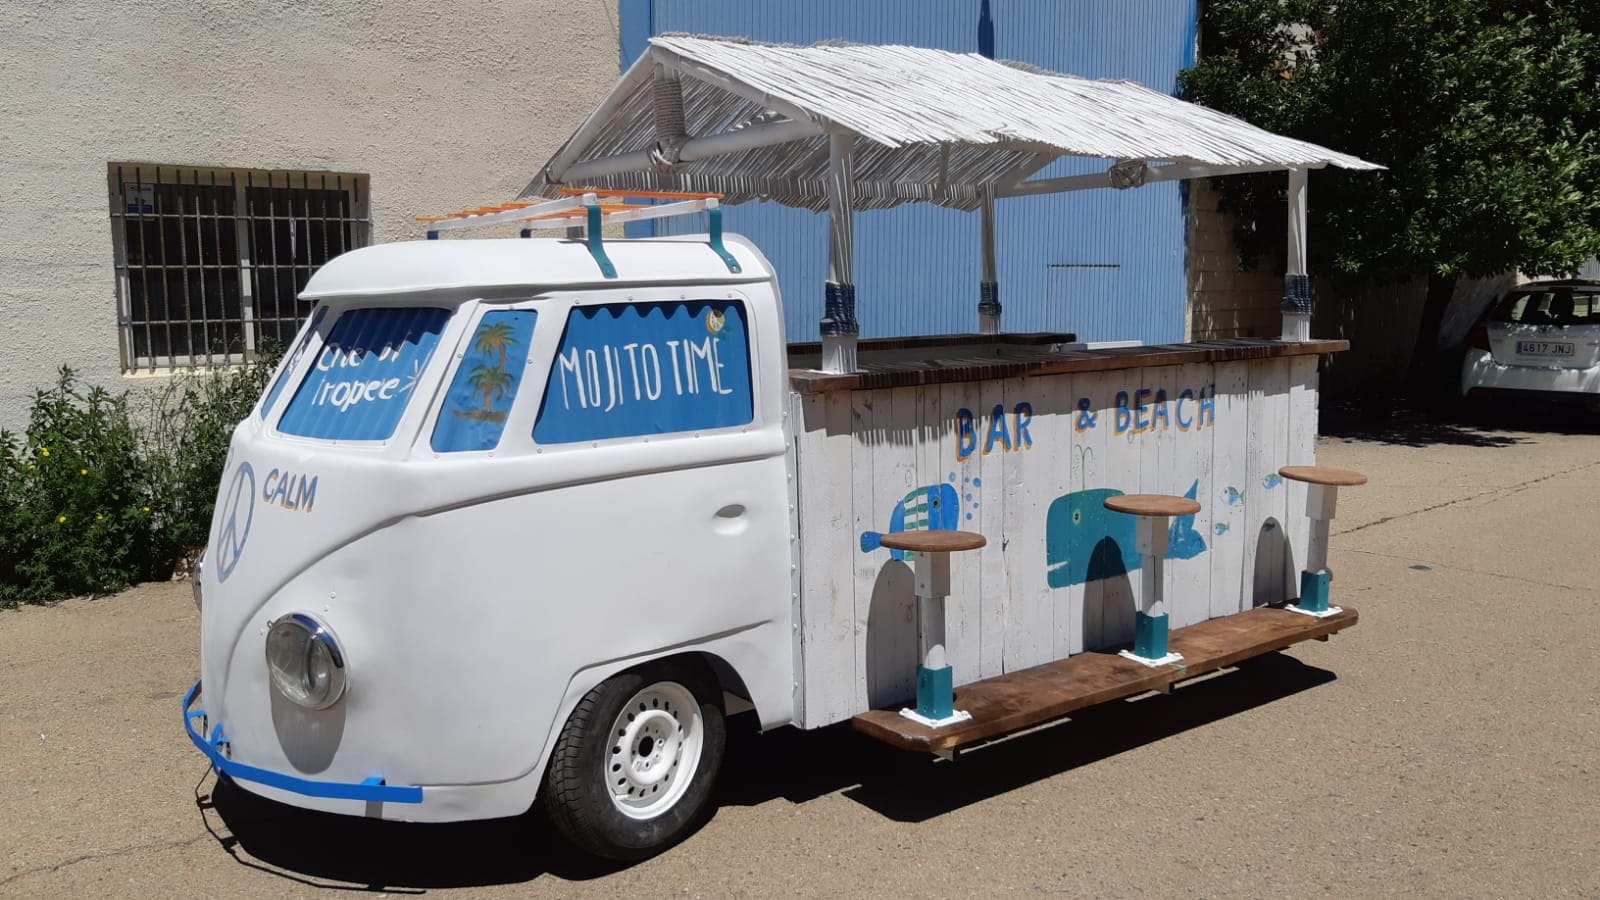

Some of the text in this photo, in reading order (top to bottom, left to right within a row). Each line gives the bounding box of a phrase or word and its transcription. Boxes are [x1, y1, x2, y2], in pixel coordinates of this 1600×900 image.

[558, 336, 733, 412] MOJITO TIME
[1551, 343, 1571, 354] JNJ
[956, 384, 1216, 462] BAR & BEACH
[262, 467, 319, 513] CALM
